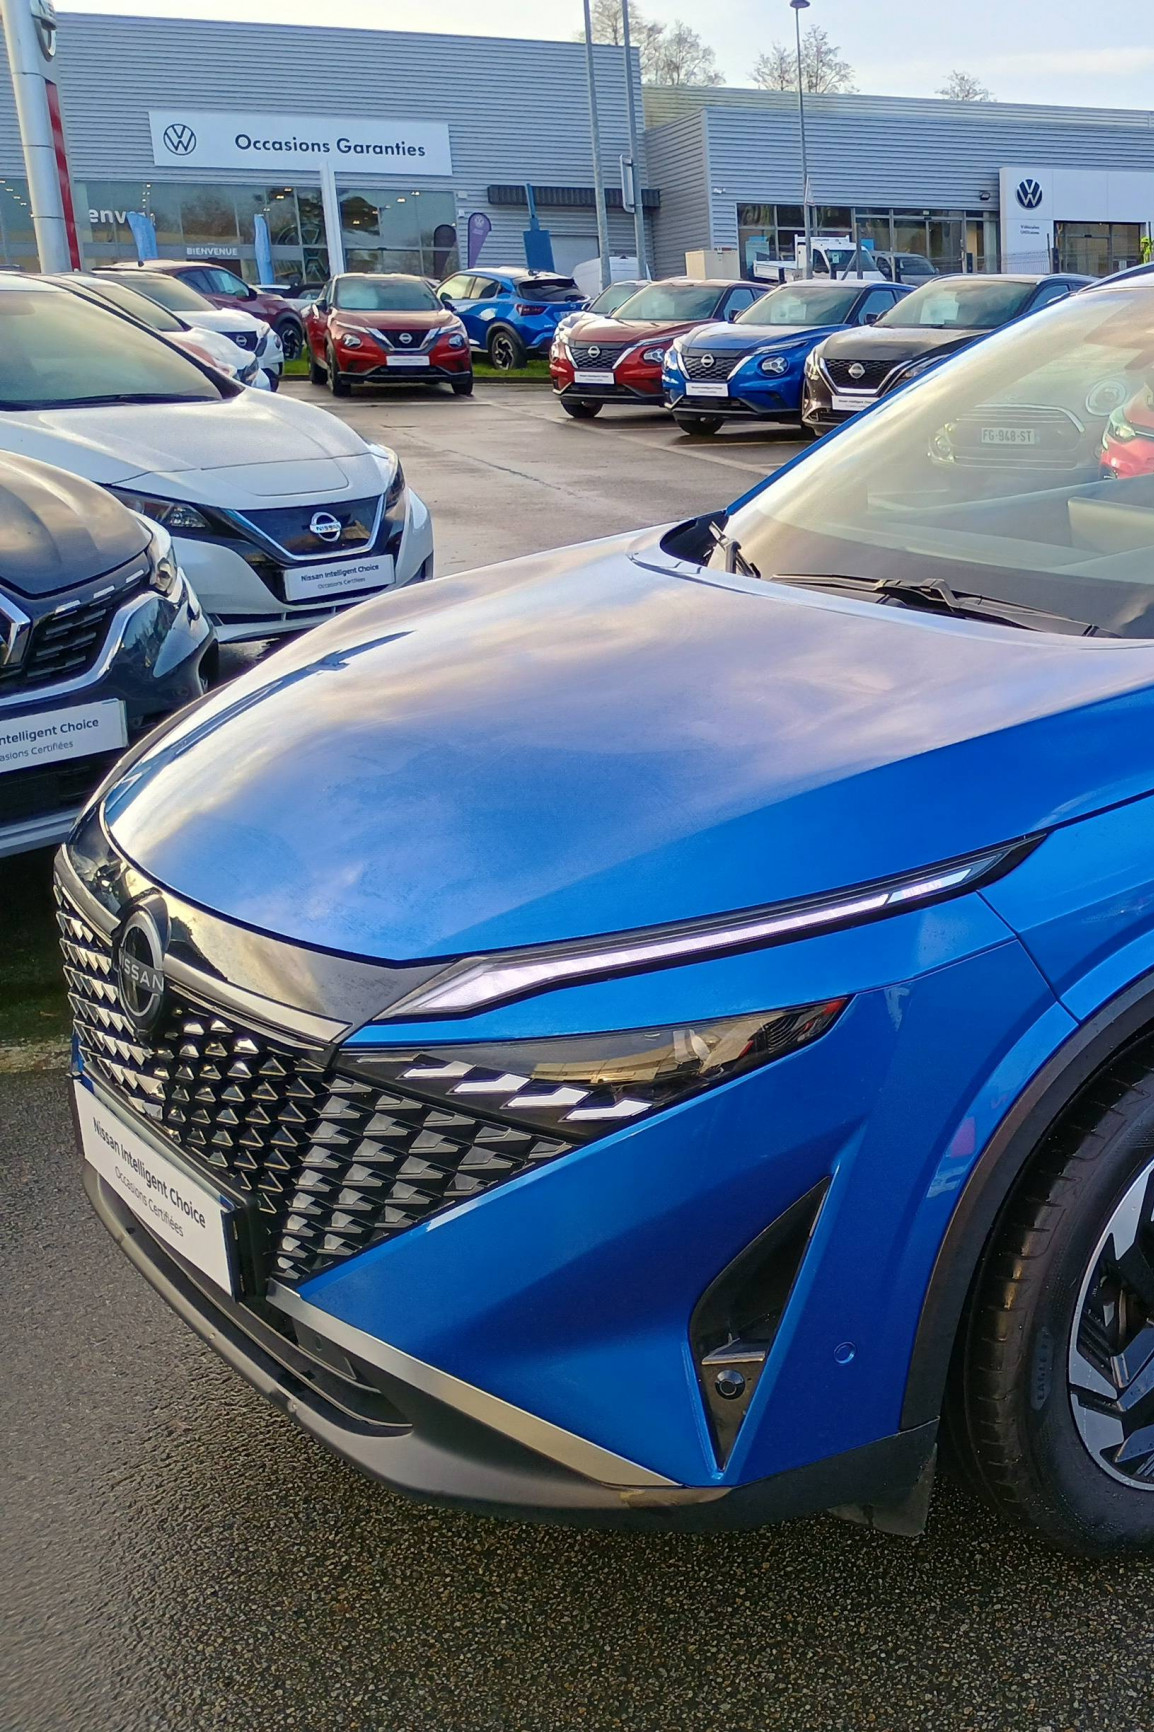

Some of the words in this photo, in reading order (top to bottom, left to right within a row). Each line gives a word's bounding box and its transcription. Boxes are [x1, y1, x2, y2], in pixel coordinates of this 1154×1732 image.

[234, 133, 331, 153] Occasions
[336, 137, 426, 157] Garanties
[186, 246, 238, 256] BIENVENUE
[301, 572, 324, 582] Nissan
[324, 567, 357, 577] Intelligent
[358, 563, 379, 573] Choice
[0, 726, 57, 746] ntelligent
[60, 719, 99, 734] Choice
[0, 749, 29, 763] asions
[31, 740, 74, 756] Certifiées
[92, 1116, 121, 1157] Nissan
[121, 1144, 168, 1200] Intelligent
[169, 1187, 206, 1229] Choice
[114, 1165, 147, 1208] Occasions
[148, 1196, 184, 1238] Certifiées
